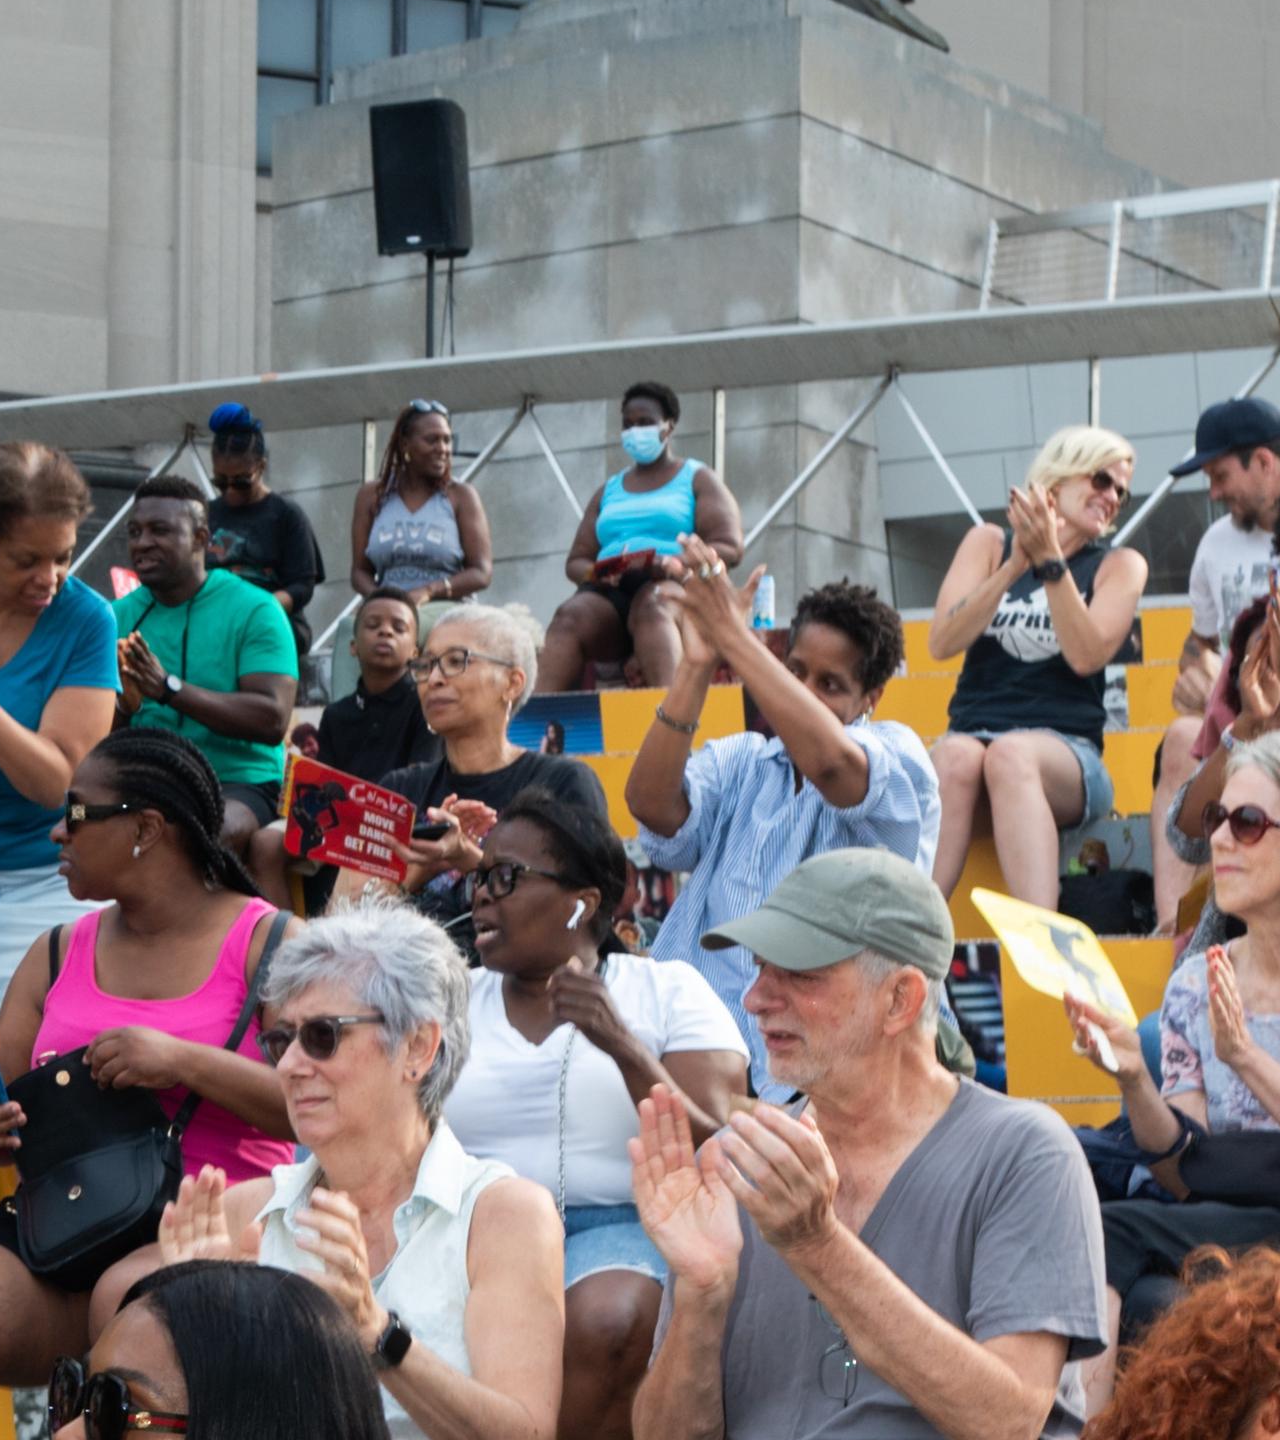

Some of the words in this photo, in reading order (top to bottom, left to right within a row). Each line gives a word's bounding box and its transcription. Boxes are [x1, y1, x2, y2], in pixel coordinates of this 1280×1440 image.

[363, 810, 396, 833] MOVE
[343, 834, 365, 852] GET
[366, 840, 393, 862] FREE
